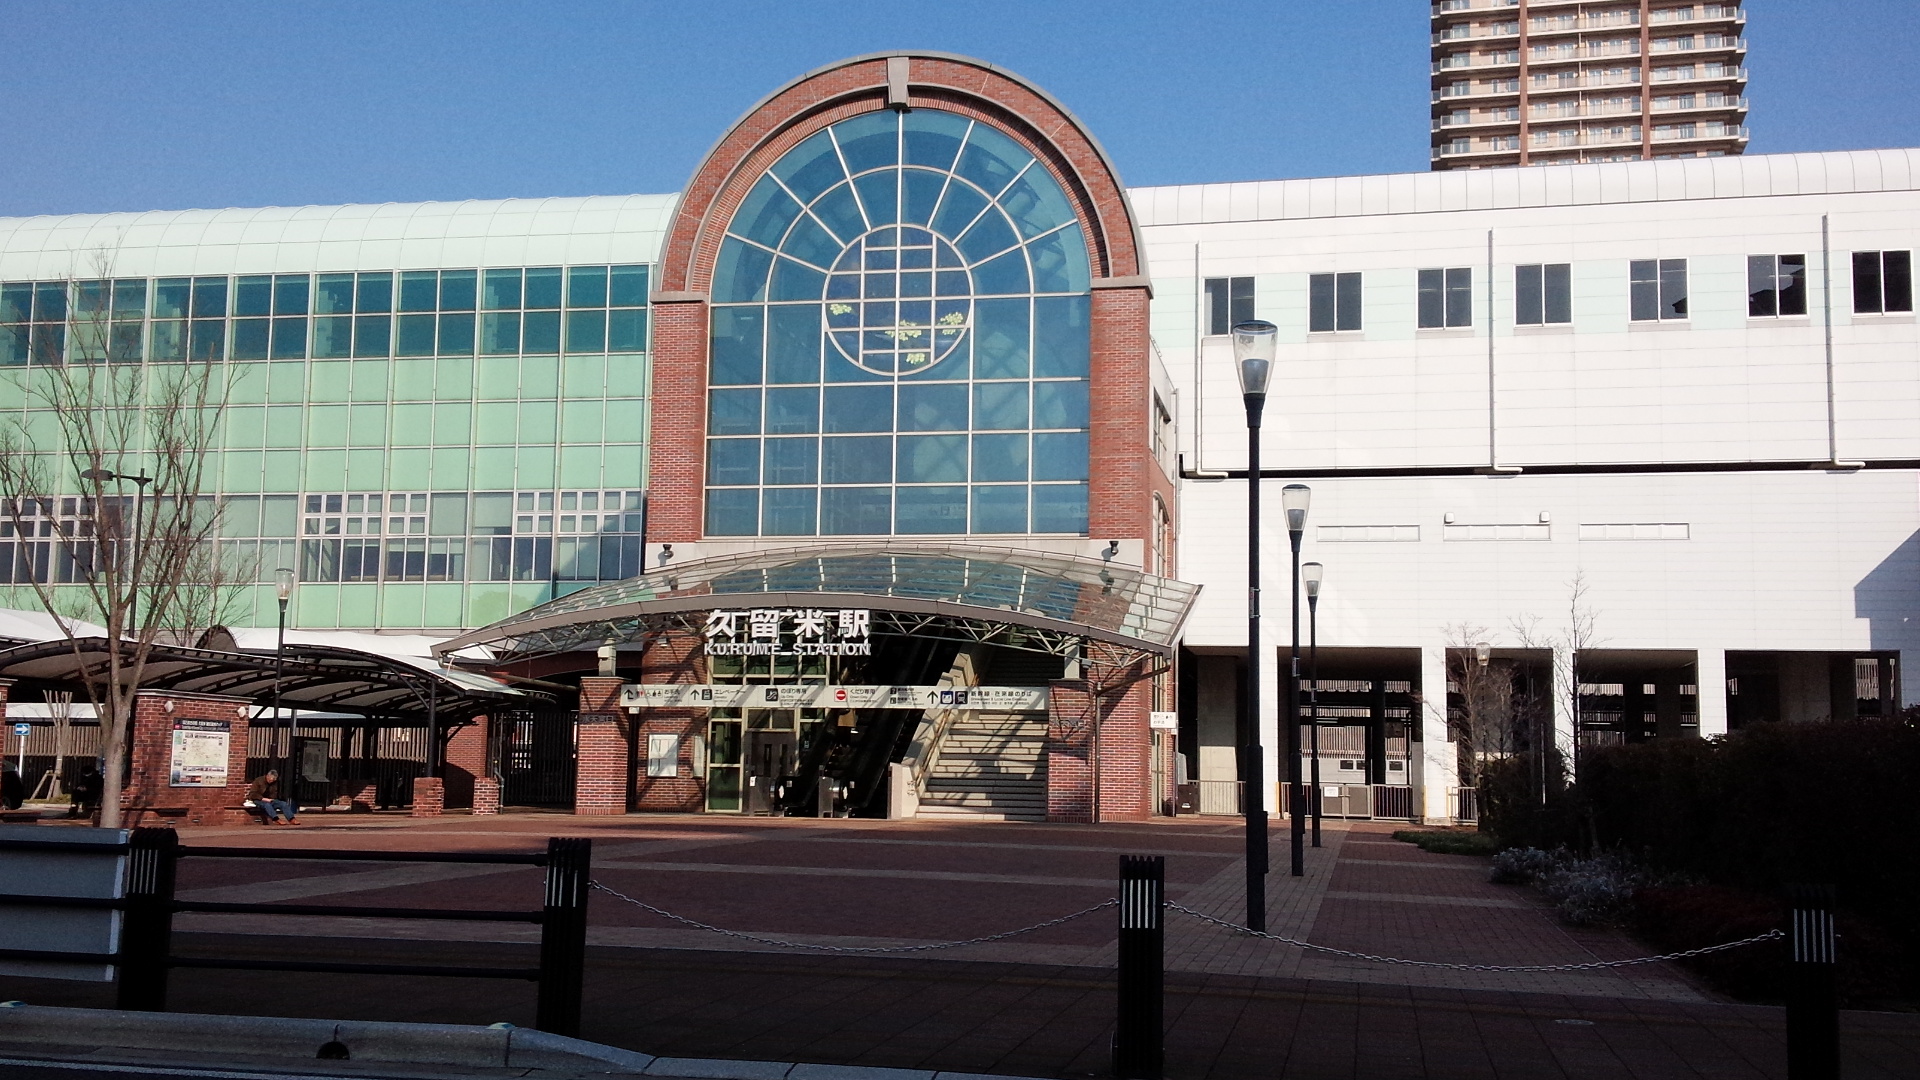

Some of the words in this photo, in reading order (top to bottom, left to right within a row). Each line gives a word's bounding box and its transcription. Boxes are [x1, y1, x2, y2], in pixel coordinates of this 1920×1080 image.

[705, 609, 871, 639] 久留米駅
[704, 642, 783, 656] KURUME
[792, 642, 872, 656] STATION
